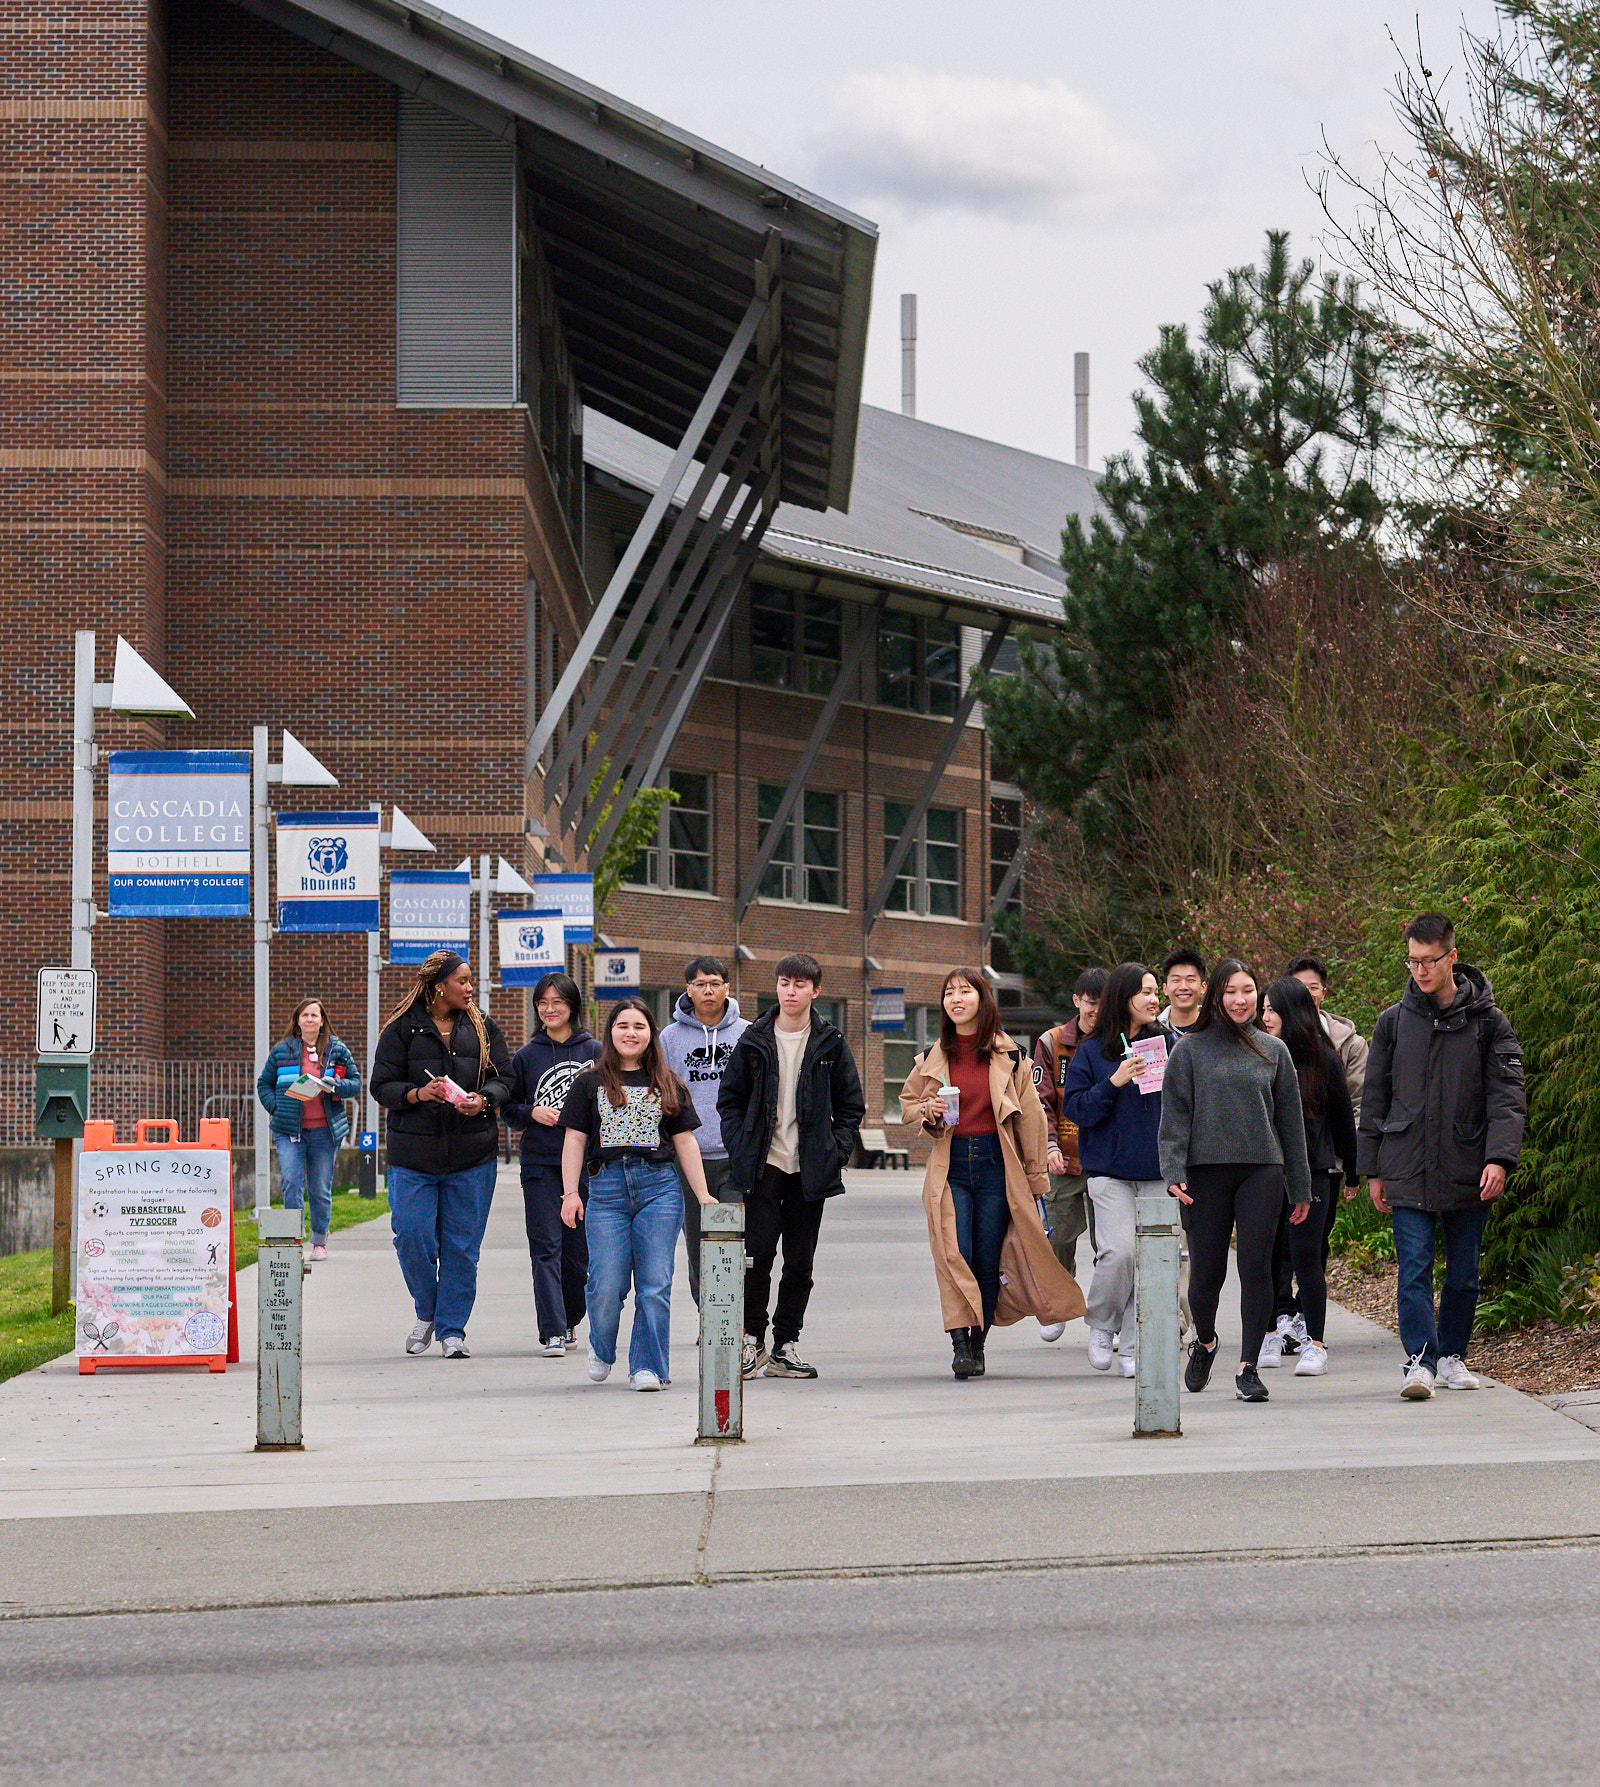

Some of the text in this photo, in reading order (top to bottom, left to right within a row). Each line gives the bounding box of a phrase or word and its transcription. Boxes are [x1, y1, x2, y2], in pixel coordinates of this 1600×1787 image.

[114, 800, 243, 818] CASCADIA
[114, 825, 245, 843] COLLEGE
[136, 856, 223, 868] BOTHELL
[113, 878, 245, 887] OUR COMMUNITY'S COLLEGE
[301, 876, 356, 891] KODIAKS
[535, 894, 591, 903] CASCADIA
[393, 898, 466, 909] CASCADIA
[393, 912, 467, 923] COLLEGE
[515, 950, 550, 961] KODIAKS
[688, 1070, 724, 1082] Root
[539, 1075, 574, 1108] Dick
[95, 1160, 212, 1181] SPRING 2023
[89, 1187, 126, 1196] Registration
[140, 1187, 164, 1196] opened
[188, 1187, 217, 1195] following
[141, 1196, 165, 1204] leagues
[121, 1205, 186, 1214] 5V5 BASKETBALL
[129, 1217, 178, 1226] 7V7 SOCCER
[166, 1229, 185, 1237] spring
[718, 1246, 725, 1255] To
[269, 1260, 291, 1269] Access
[270, 1269, 289, 1278] Please
[272, 1312, 286, 1321] After
